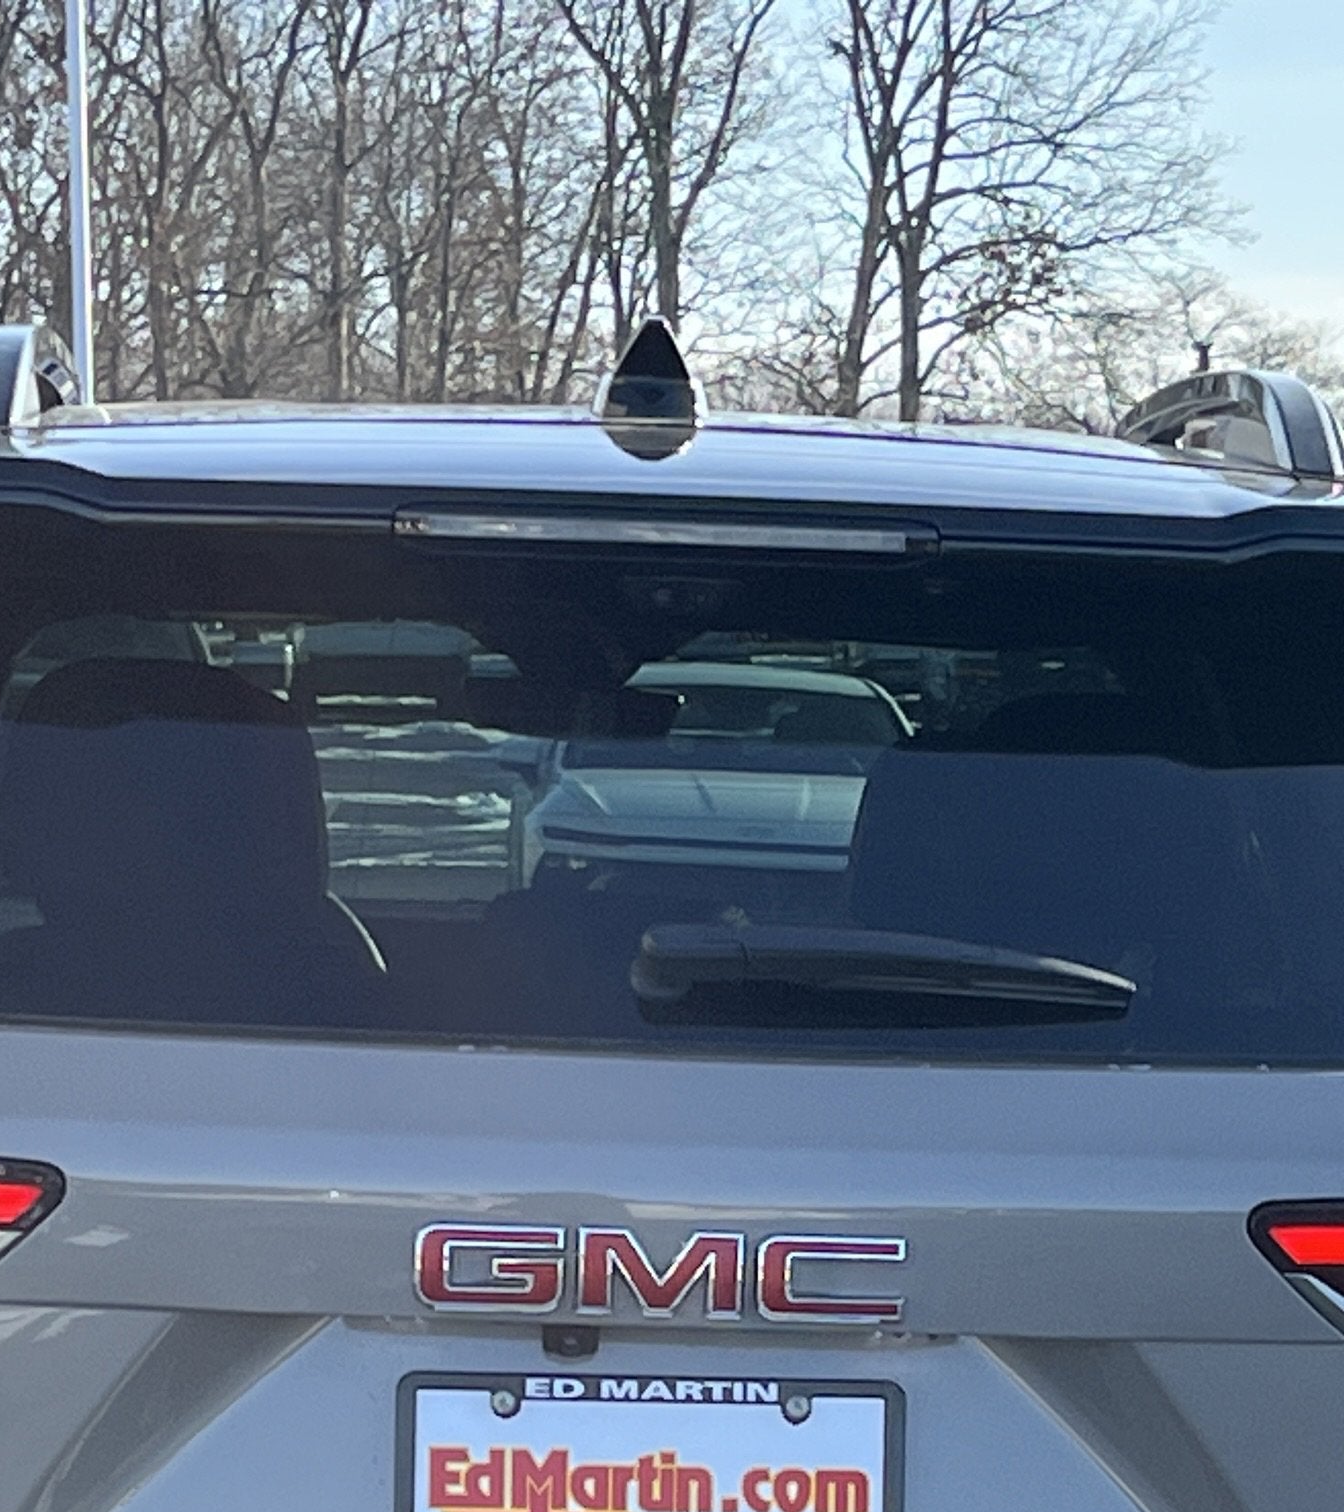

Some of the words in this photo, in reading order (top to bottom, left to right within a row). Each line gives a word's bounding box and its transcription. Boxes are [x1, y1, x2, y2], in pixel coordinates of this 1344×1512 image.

[414, 1221, 906, 1323] GMC
[523, 1377, 586, 1400] ED
[599, 1379, 780, 1404] MARTIN
